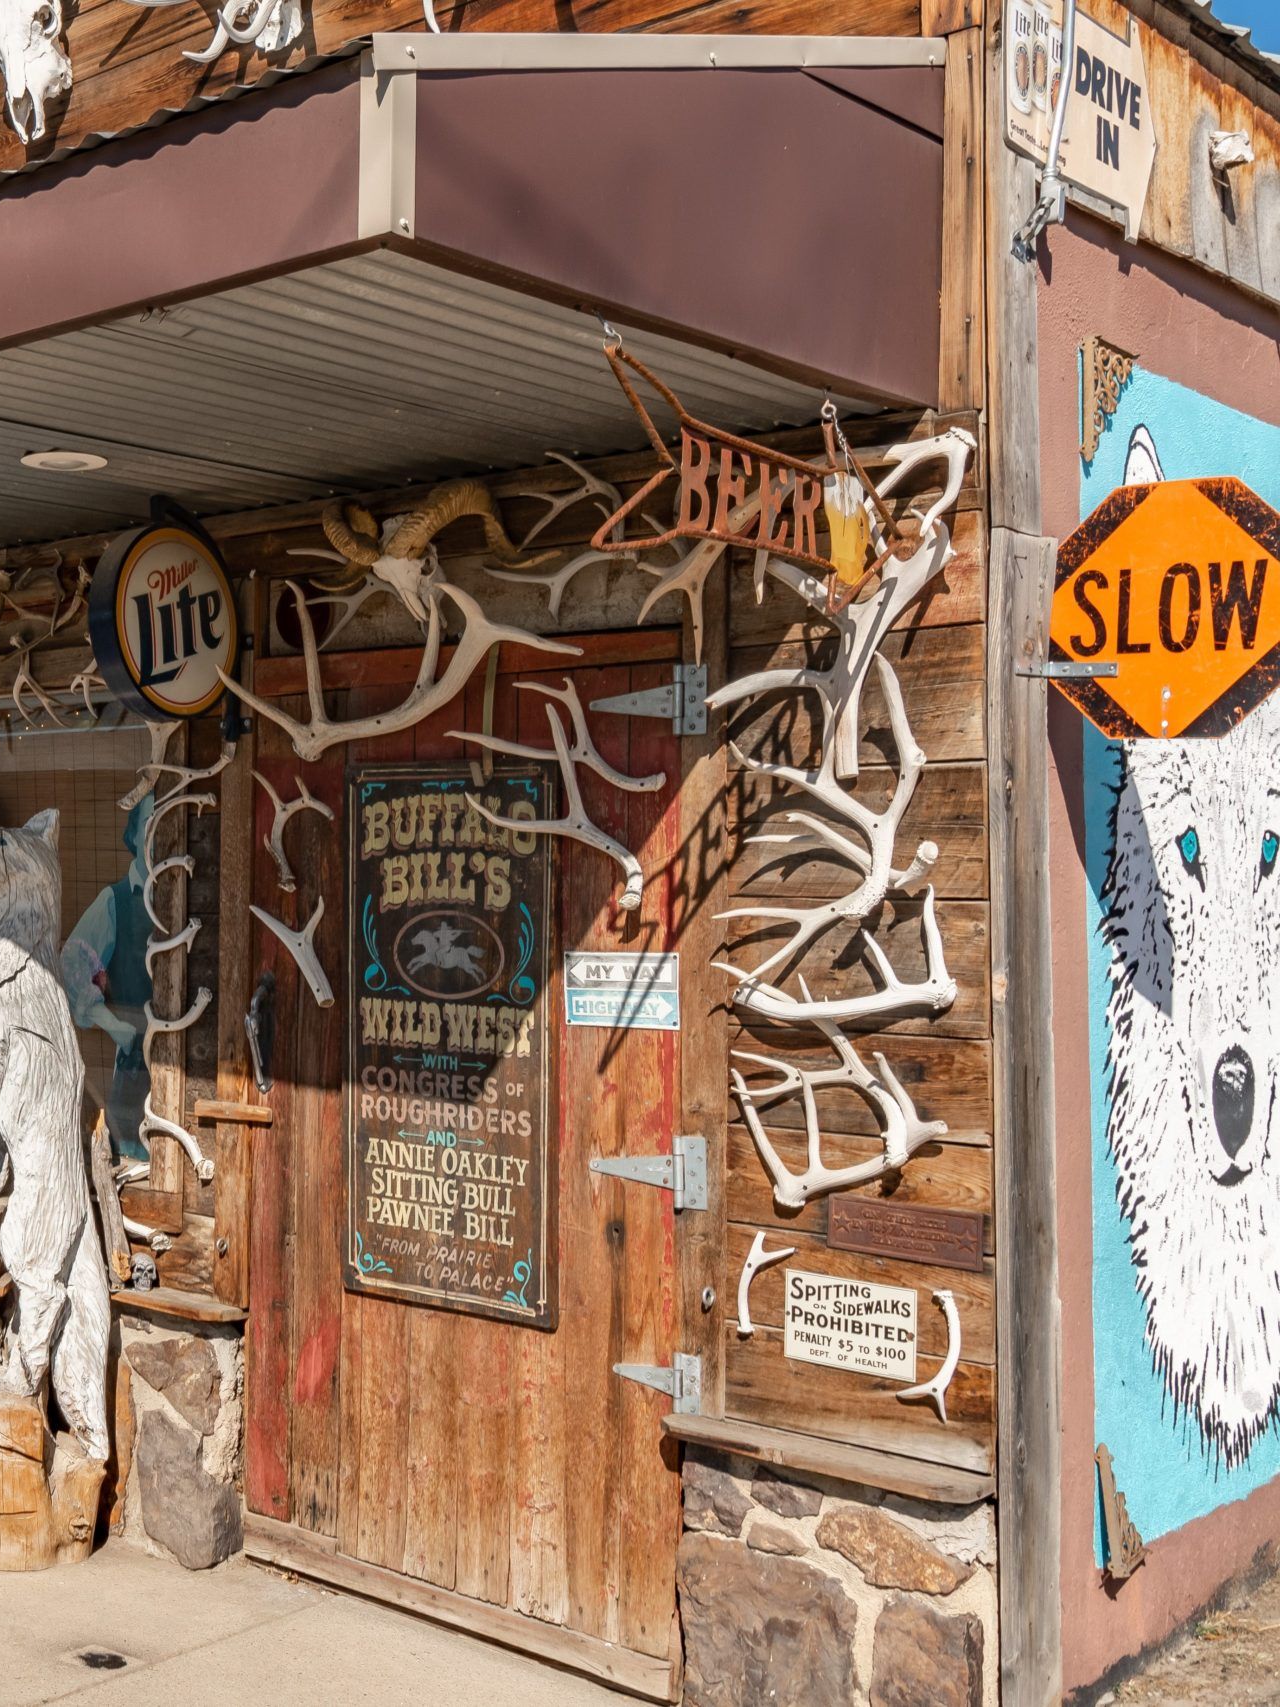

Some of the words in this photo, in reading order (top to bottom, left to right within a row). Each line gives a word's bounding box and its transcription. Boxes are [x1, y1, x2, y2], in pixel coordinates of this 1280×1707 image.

[1015, 9, 1030, 37] Lite
[1034, 9, 1049, 37] Lite
[1051, 37, 1063, 63] Lit
[1075, 45, 1142, 131] DRIVE
[1095, 114, 1120, 171] IN
[677, 426, 821, 557] BEER
[147, 559, 199, 601] Miller
[1070, 558, 1269, 657] SLOW
[131, 582, 225, 688] Lite
[362, 793, 537, 858] BUFFALO
[380, 852, 512, 912] BILL'S
[585, 964, 614, 979] MY
[623, 965, 665, 980] WAY
[574, 999, 660, 1016] HIGHWAY
[360, 997, 442, 1049] WILD
[443, 1002, 535, 1059] WEST
[422, 1053, 458, 1071] WITH
[361, 1065, 498, 1104] CONGRESS
[505, 1082, 525, 1098] OF
[361, 1093, 533, 1138] ROUGHRIDERS
[425, 1129, 458, 1148] AND
[364, 1137, 436, 1173] ANNIE
[441, 1147, 530, 1187] OAKLEY
[371, 1167, 459, 1206] SITTING
[461, 1181, 516, 1217] BULL
[366, 1196, 455, 1239] PAWNEE
[462, 1211, 515, 1248] BILL
[416, 1261, 433, 1279] TO
[425, 1244, 493, 1270] PRAIRIE
[790, 1277, 872, 1301] SPITTING
[832, 1299, 911, 1318] SIDEWALKS
[791, 1304, 913, 1343] PROHIBITED
[794, 1330, 832, 1347] PENALTY
[838, 1339, 854, 1352] $5
[858, 1345, 870, 1355] TO
[875, 1346, 907, 1361] $100
[809, 1348, 832, 1359] DEPT.
[837, 1354, 849, 1362] OF
[855, 1357, 888, 1370] HEALTH
